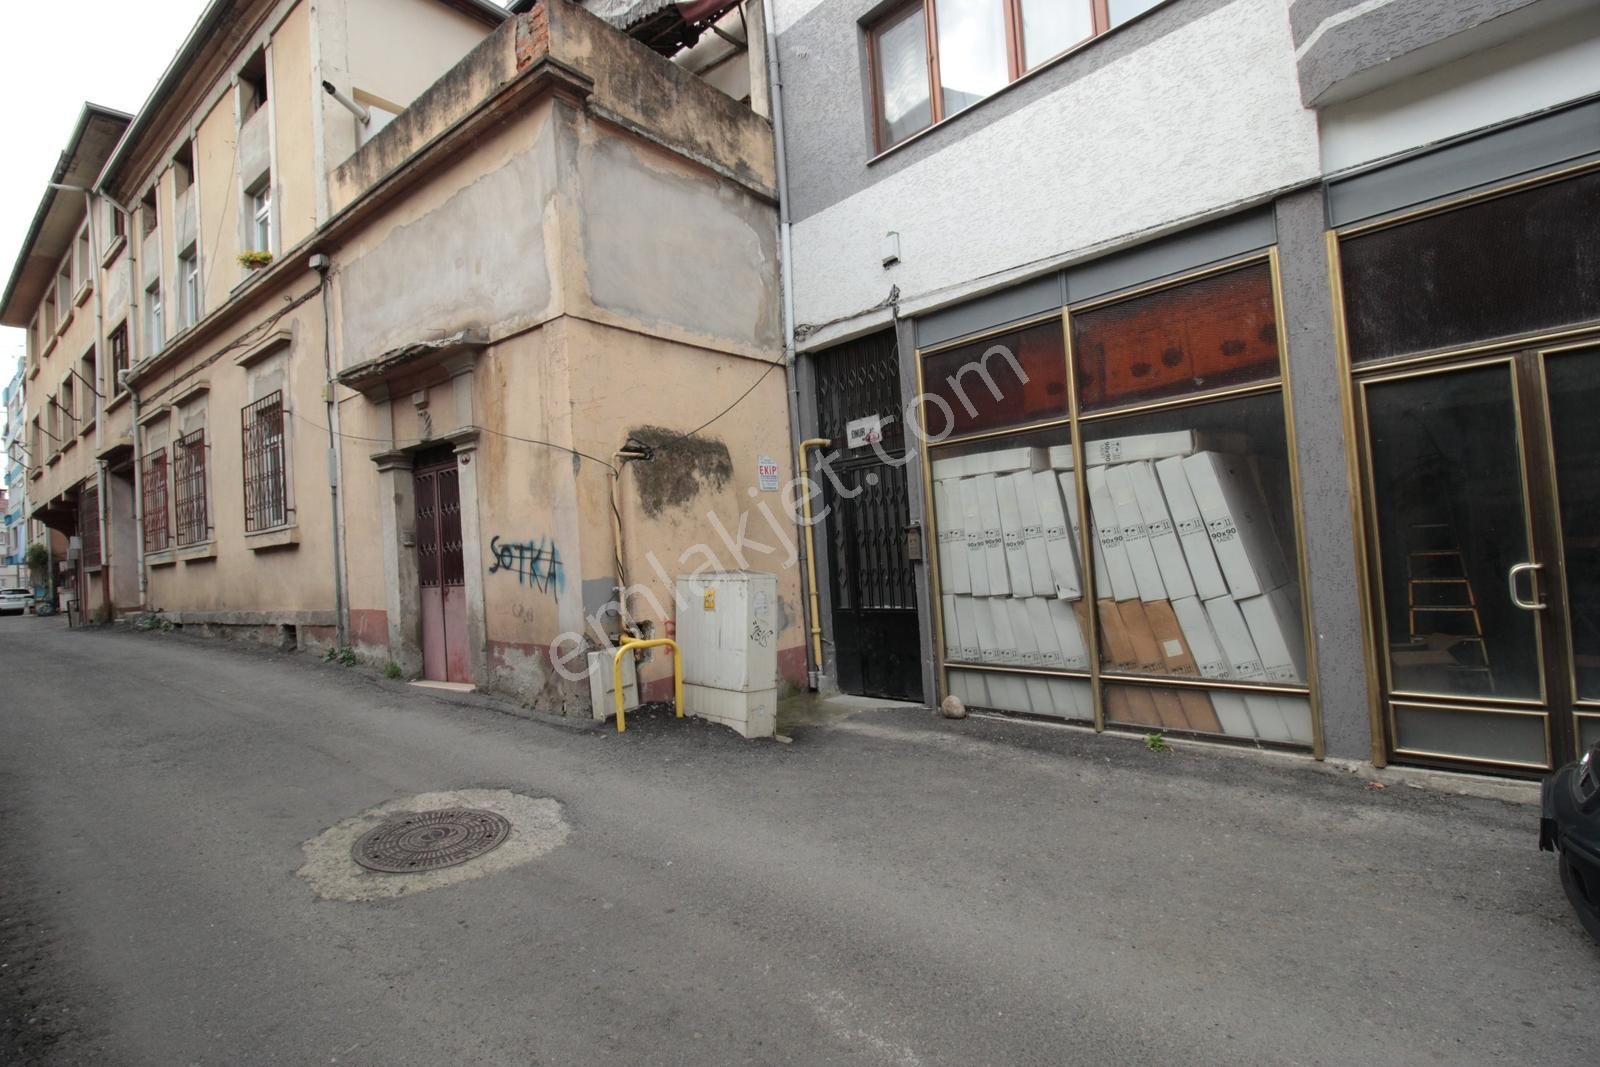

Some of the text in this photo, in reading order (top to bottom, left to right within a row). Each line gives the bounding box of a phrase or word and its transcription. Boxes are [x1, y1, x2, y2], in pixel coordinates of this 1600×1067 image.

[1211, 527, 1237, 540] 90x90
[1006, 540, 1025, 548] 90x90
[1101, 535, 1123, 545] 90x90
